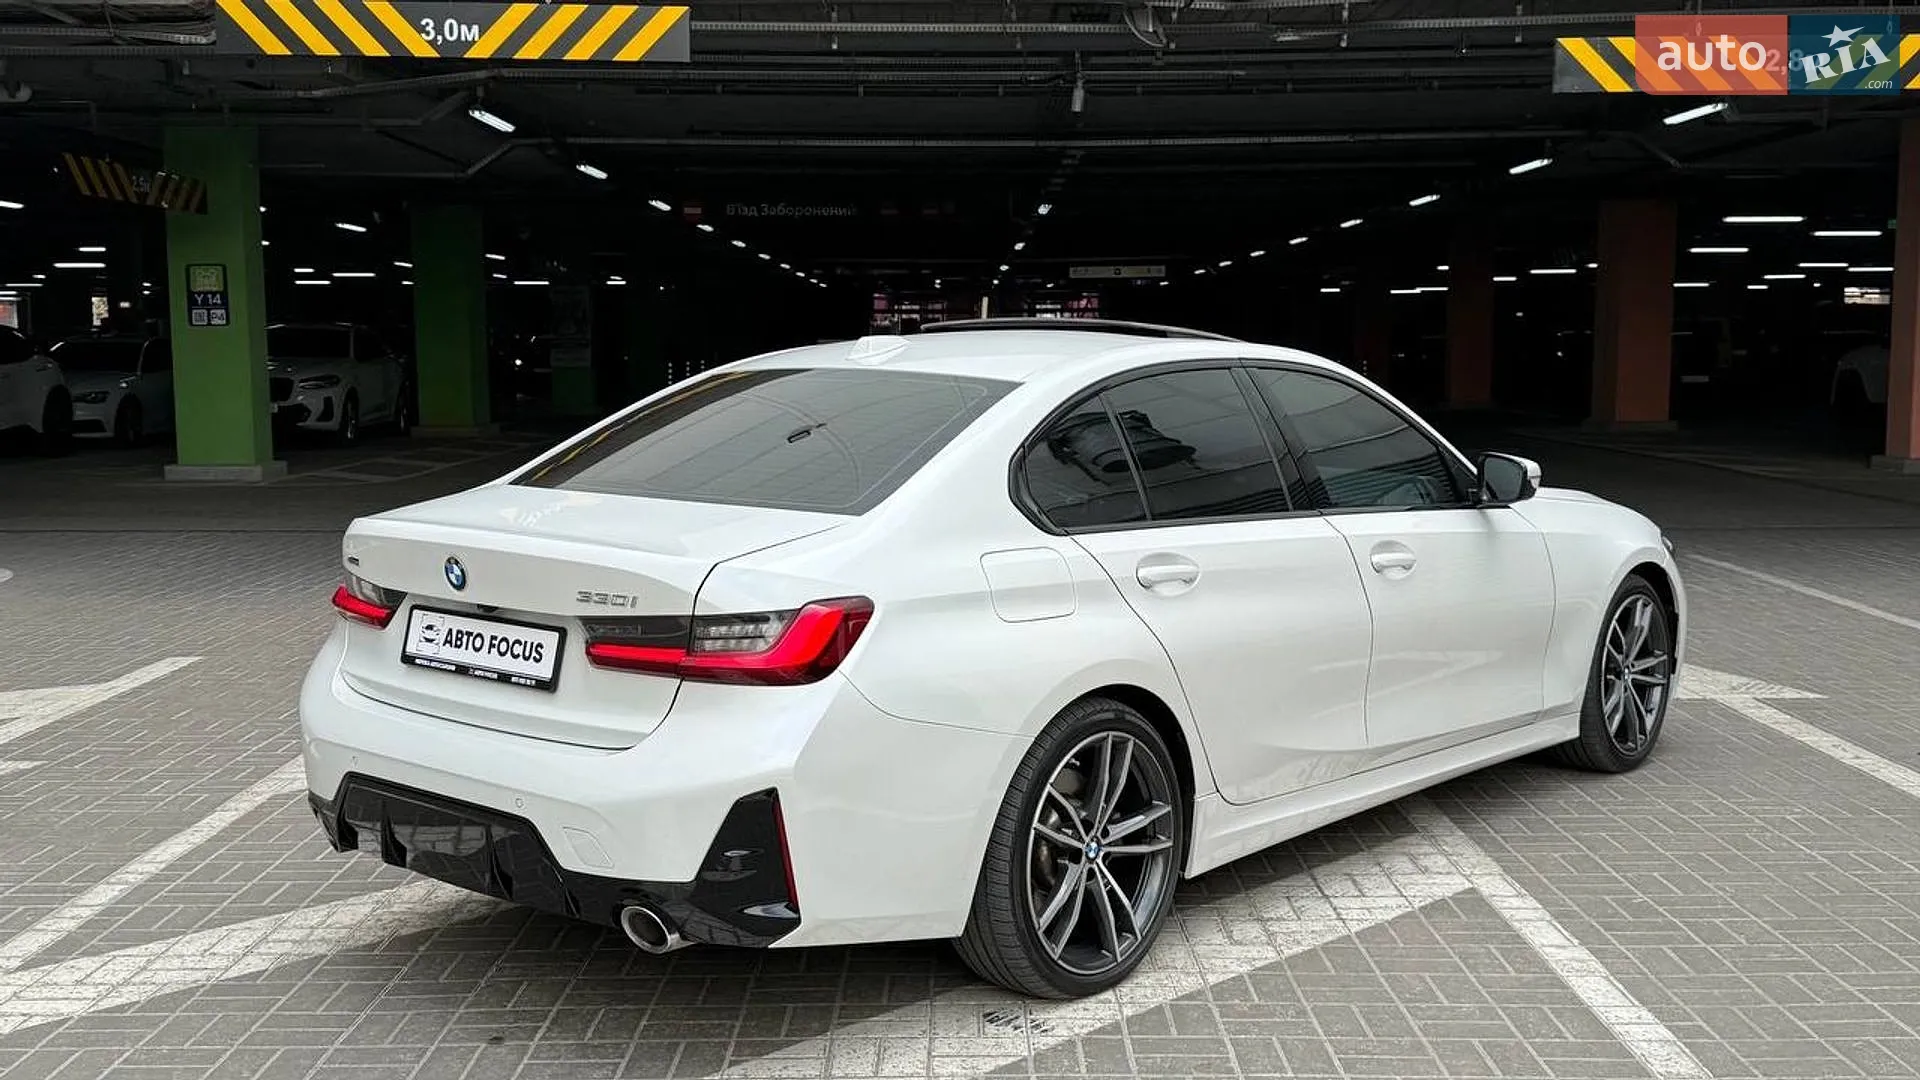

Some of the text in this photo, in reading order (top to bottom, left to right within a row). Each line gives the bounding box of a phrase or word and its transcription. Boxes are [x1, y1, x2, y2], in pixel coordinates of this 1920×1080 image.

[420, 18, 479, 45] 3,0м
[194, 293, 222, 306] Y 14
[443, 627, 545, 664] АВТО FOCUS
